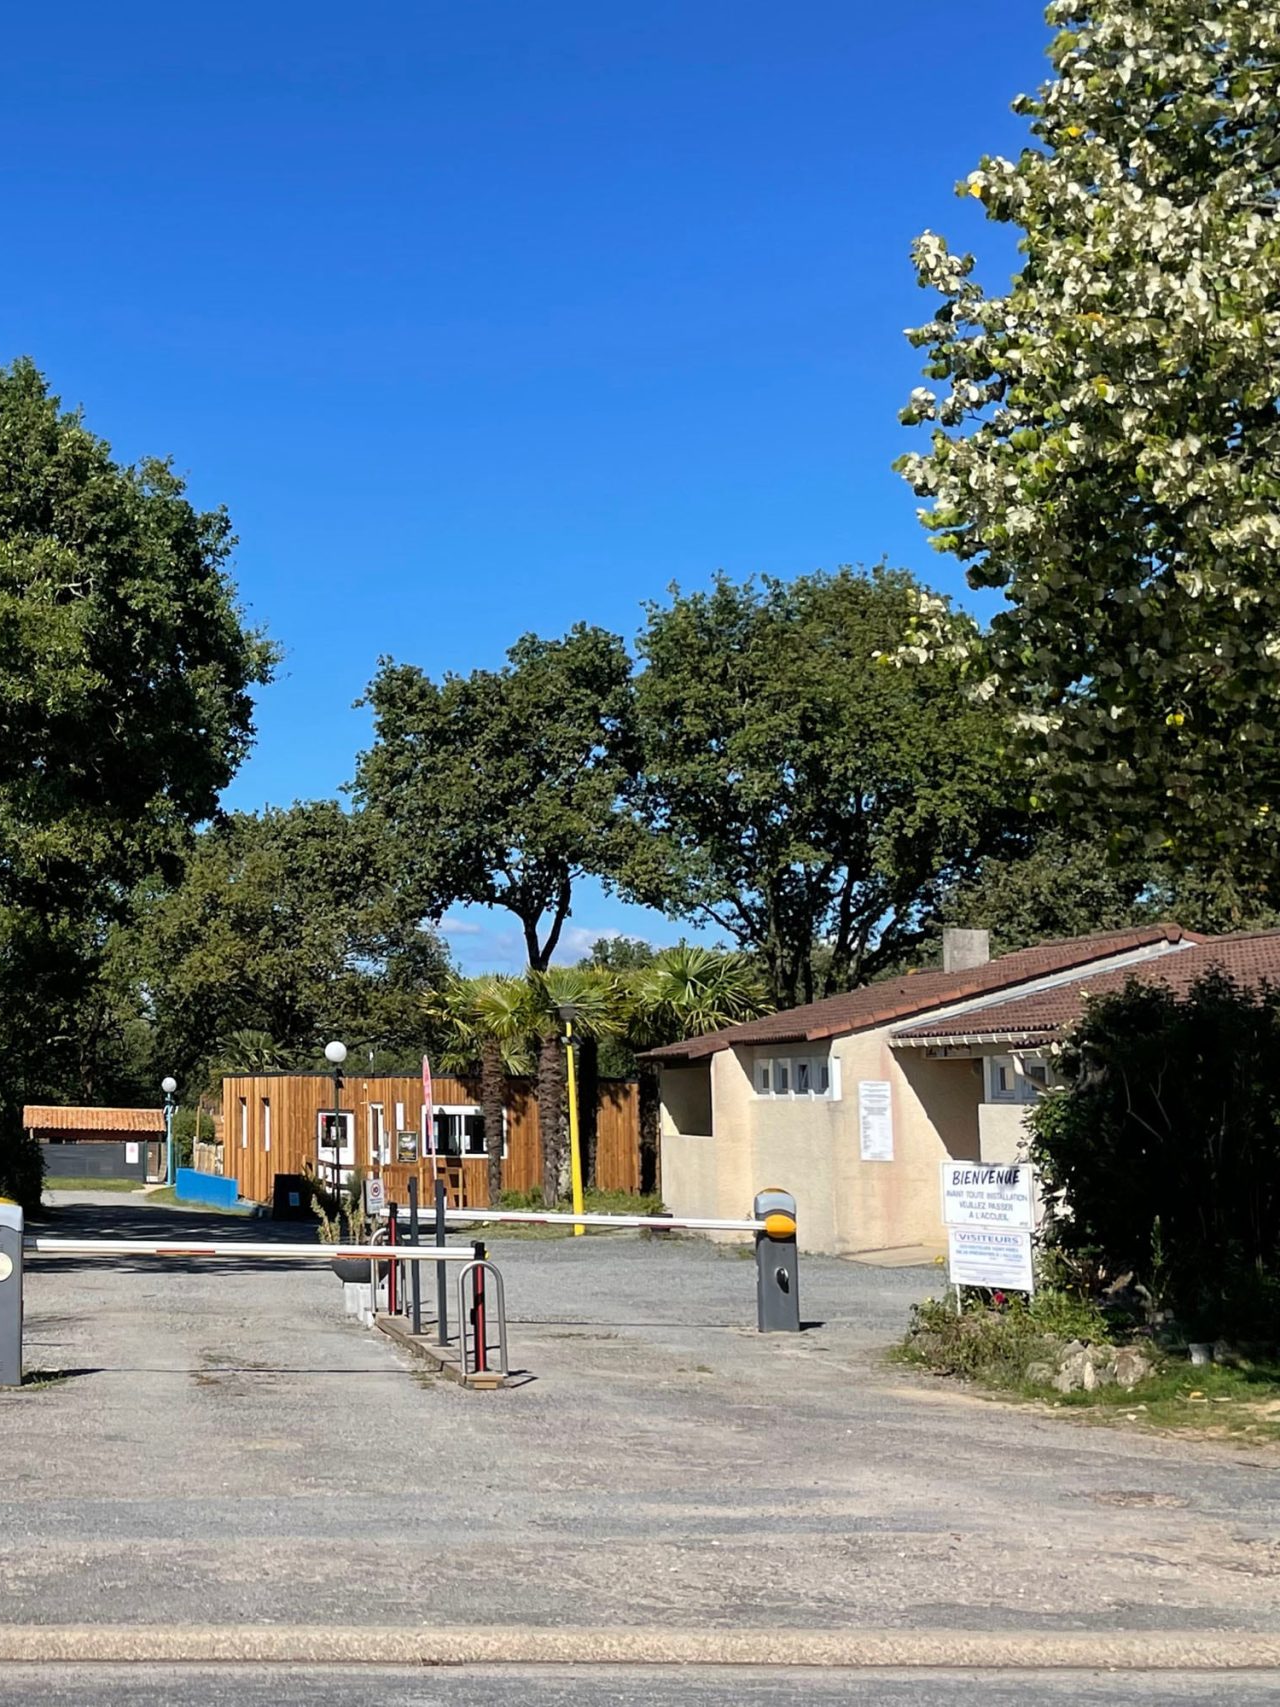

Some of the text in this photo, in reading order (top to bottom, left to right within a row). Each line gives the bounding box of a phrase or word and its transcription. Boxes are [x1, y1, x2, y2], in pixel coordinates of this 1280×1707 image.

[952, 1169, 1020, 1185] BIENVENUE
[966, 1191, 984, 1199] TOUTE
[987, 1192, 1027, 1201] INSTALLATION
[959, 1201, 1013, 1211] VEUILLEZ PASSER
[959, 1233, 1019, 1244] VISITEURS
